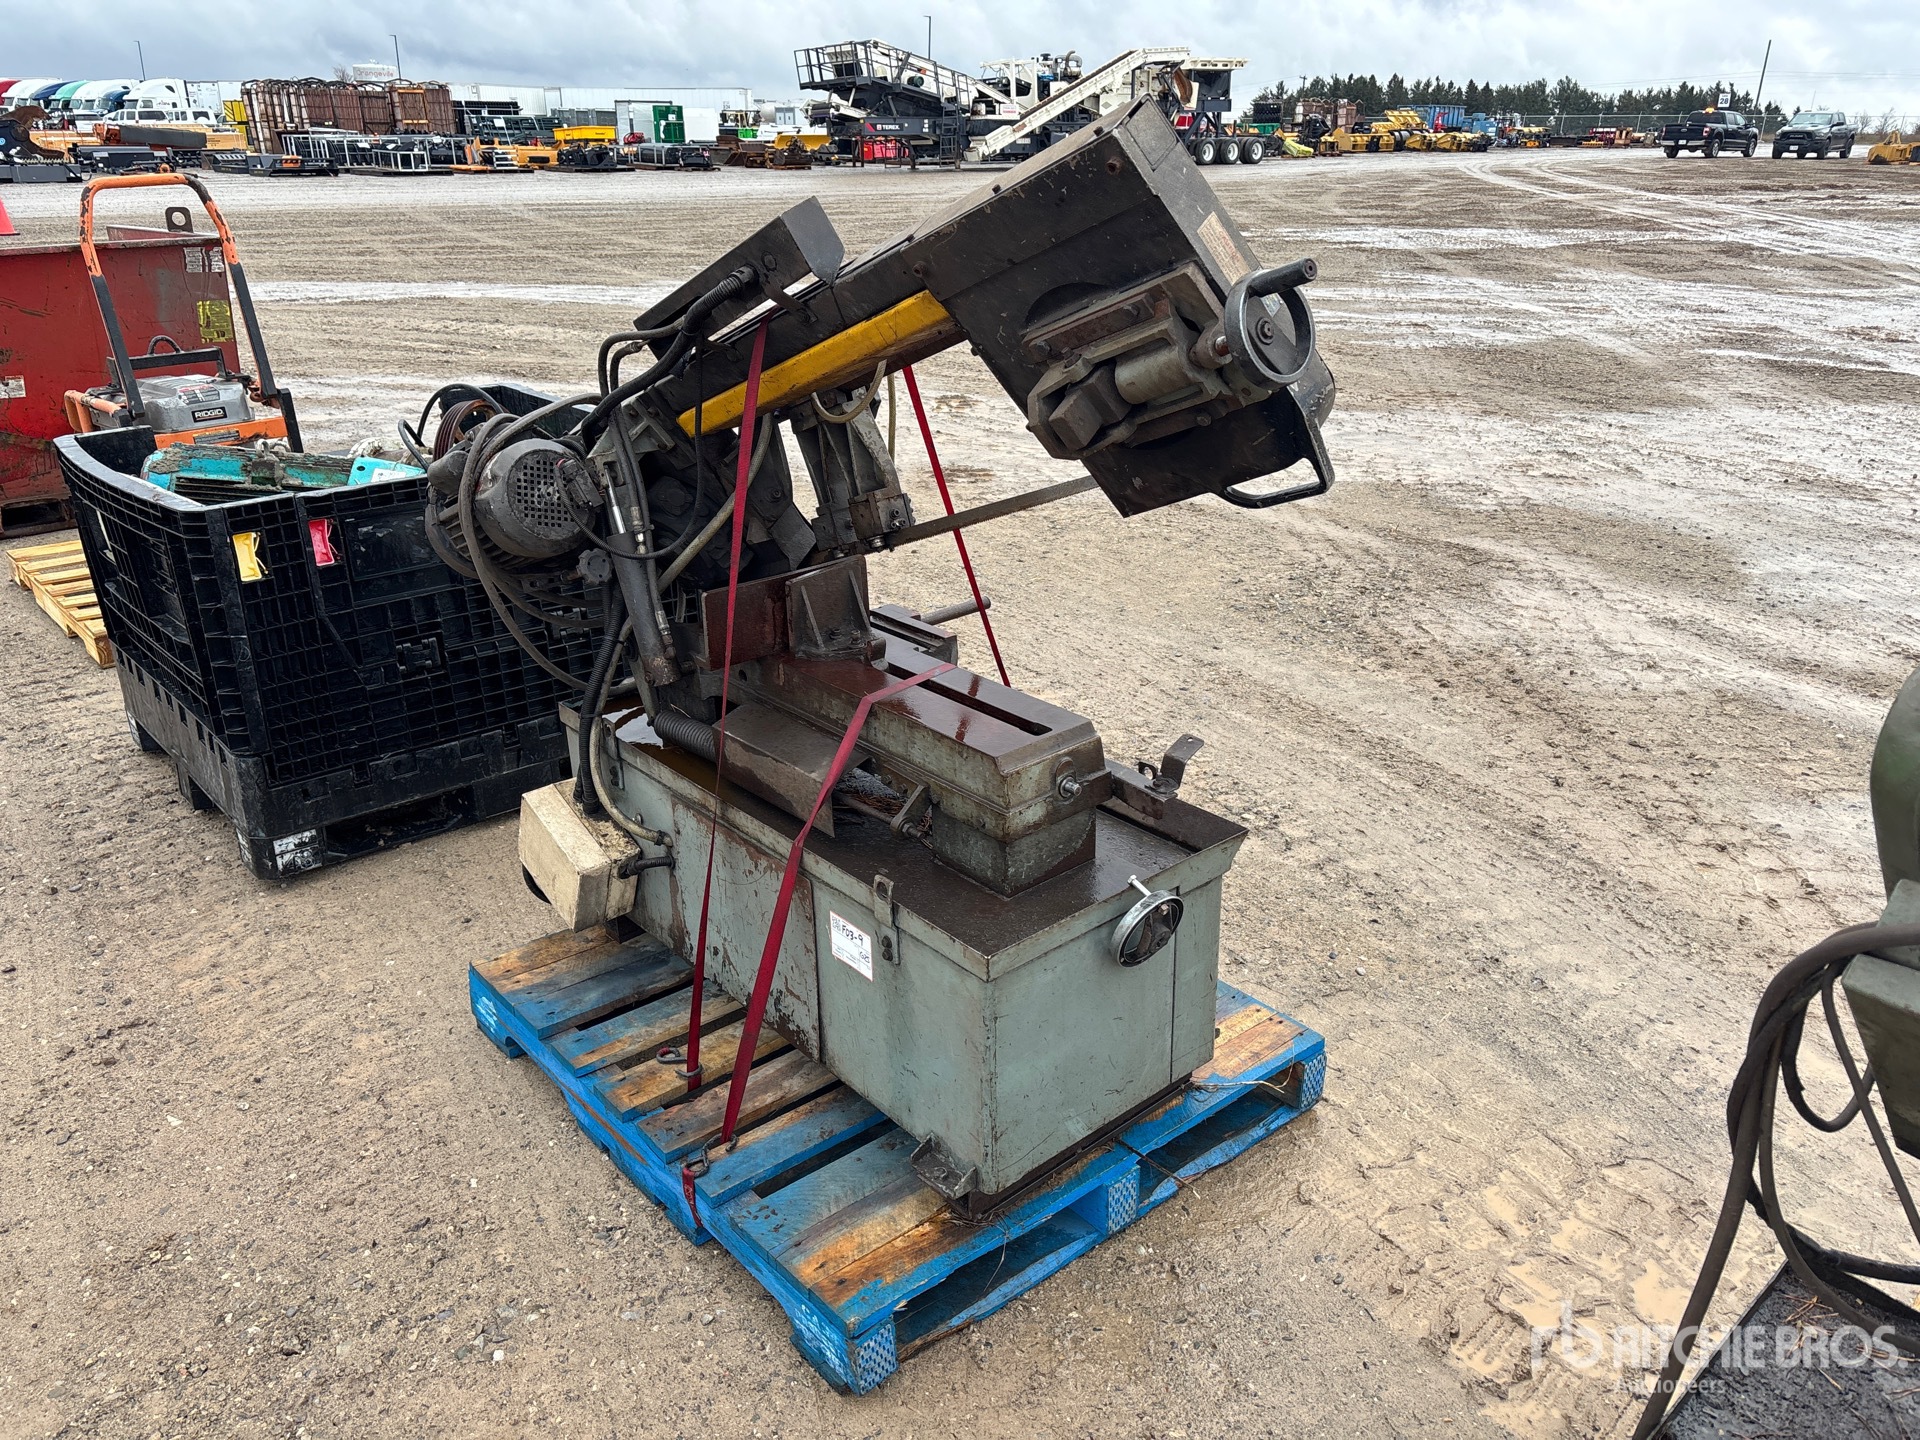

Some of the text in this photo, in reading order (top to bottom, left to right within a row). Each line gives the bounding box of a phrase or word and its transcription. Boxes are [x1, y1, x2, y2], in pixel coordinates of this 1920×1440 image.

[356, 69, 394, 78] Orangeville
[1719, 97, 1729, 105] 28
[194, 408, 224, 418] RIDGID
